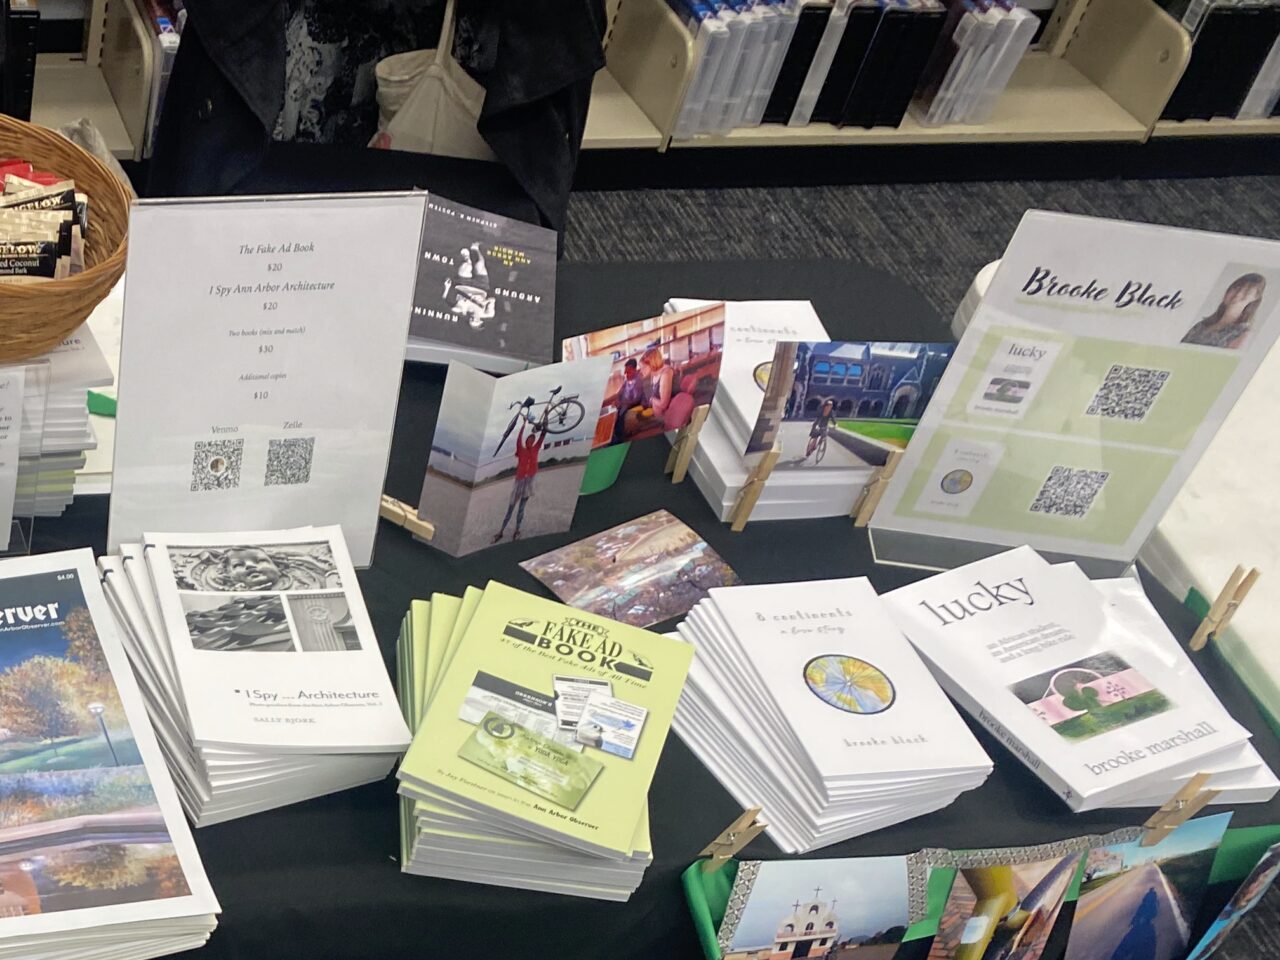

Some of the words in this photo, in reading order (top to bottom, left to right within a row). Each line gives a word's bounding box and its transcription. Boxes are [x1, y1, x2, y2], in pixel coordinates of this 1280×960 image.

[466, 216, 498, 228] STEPHEN
[239, 245, 254, 254] The
[256, 245, 276, 254] Fake
[278, 243, 292, 253] Ad
[293, 242, 314, 253] Book
[10, 259, 39, 267] Coconut
[424, 251, 454, 265] TOWN
[268, 263, 282, 272] $20
[210, 286, 214, 295] I
[216, 285, 232, 297] Spy
[234, 284, 252, 294] Ann
[254, 282, 280, 292] Arbor
[282, 280, 335, 292] Architecture
[1022, 266, 1110, 301] Brooke
[1115, 281, 1184, 310] Black
[495, 288, 541, 304] AROUND
[263, 302, 278, 310] $20
[411, 306, 458, 322] RUNNIN
[1008, 344, 1047, 359] lucky
[254, 392, 268, 400] $10
[212, 426, 238, 434] Venmo
[283, 421, 302, 430] Zelle
[57, 573, 75, 581] $4.00
[919, 578, 1034, 626] lucky
[773, 608, 853, 621] continents
[542, 622, 594, 650] FAKE
[595, 639, 623, 658] AD
[537, 636, 616, 670] BOOK
[512, 641, 523, 649] of
[523, 643, 536, 653] the
[539, 649, 556, 660] Best
[558, 657, 579, 667] Fake
[580, 663, 596, 672] Ads
[598, 669, 607, 678] of
[609, 672, 622, 681] All
[624, 677, 648, 689] Time
[254, 690, 278, 701] Spy
[298, 690, 379, 700] Architecture
[844, 738, 887, 748] brooke
[892, 734, 928, 744] black
[979, 708, 1007, 738] brooke
[1006, 735, 1041, 770] marshall
[1084, 749, 1147, 776] brooke
[1148, 721, 1218, 755] marshall
[533, 804, 547, 813] Ann
[549, 809, 568, 820] Arbor
[570, 817, 599, 830] Observer
